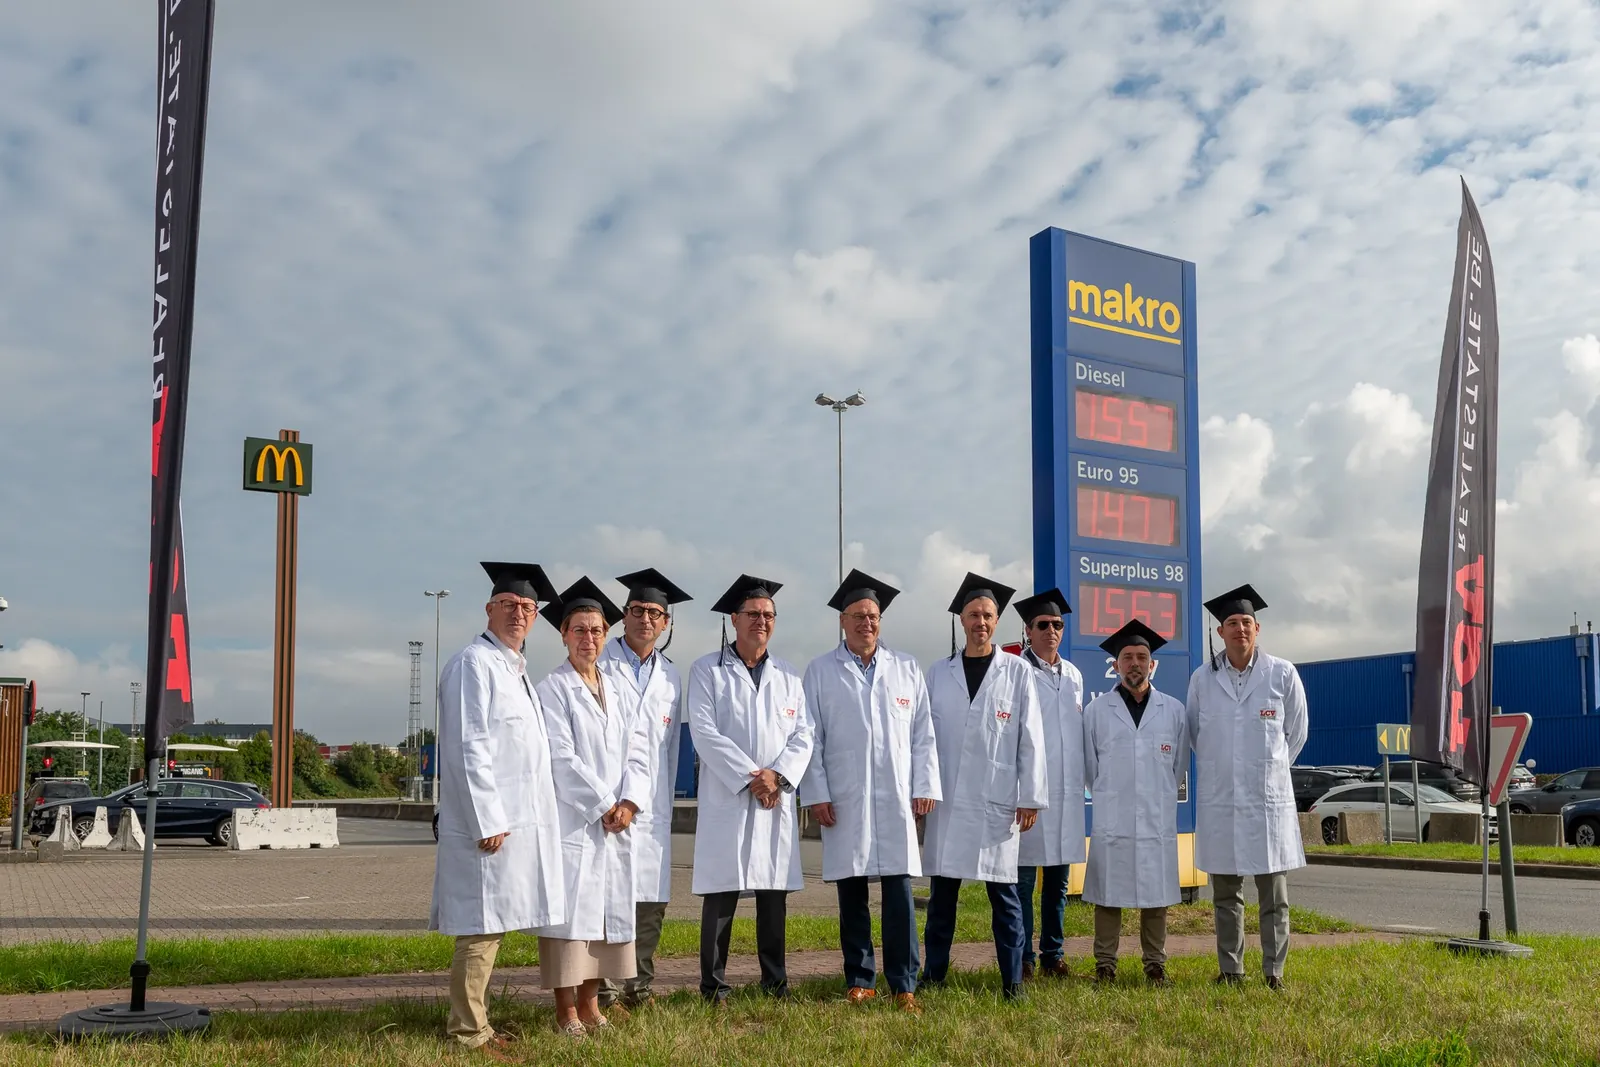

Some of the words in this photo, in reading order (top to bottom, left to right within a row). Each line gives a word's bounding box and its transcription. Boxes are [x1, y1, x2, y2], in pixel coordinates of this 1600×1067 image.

[1068, 280, 1181, 334] makro
[1075, 362, 1125, 387] Diesel
[1077, 461, 1113, 481] Euro
[1119, 467, 1139, 485] 95
[1080, 556, 1159, 581] Superplus
[1164, 565, 1184, 582] 98
